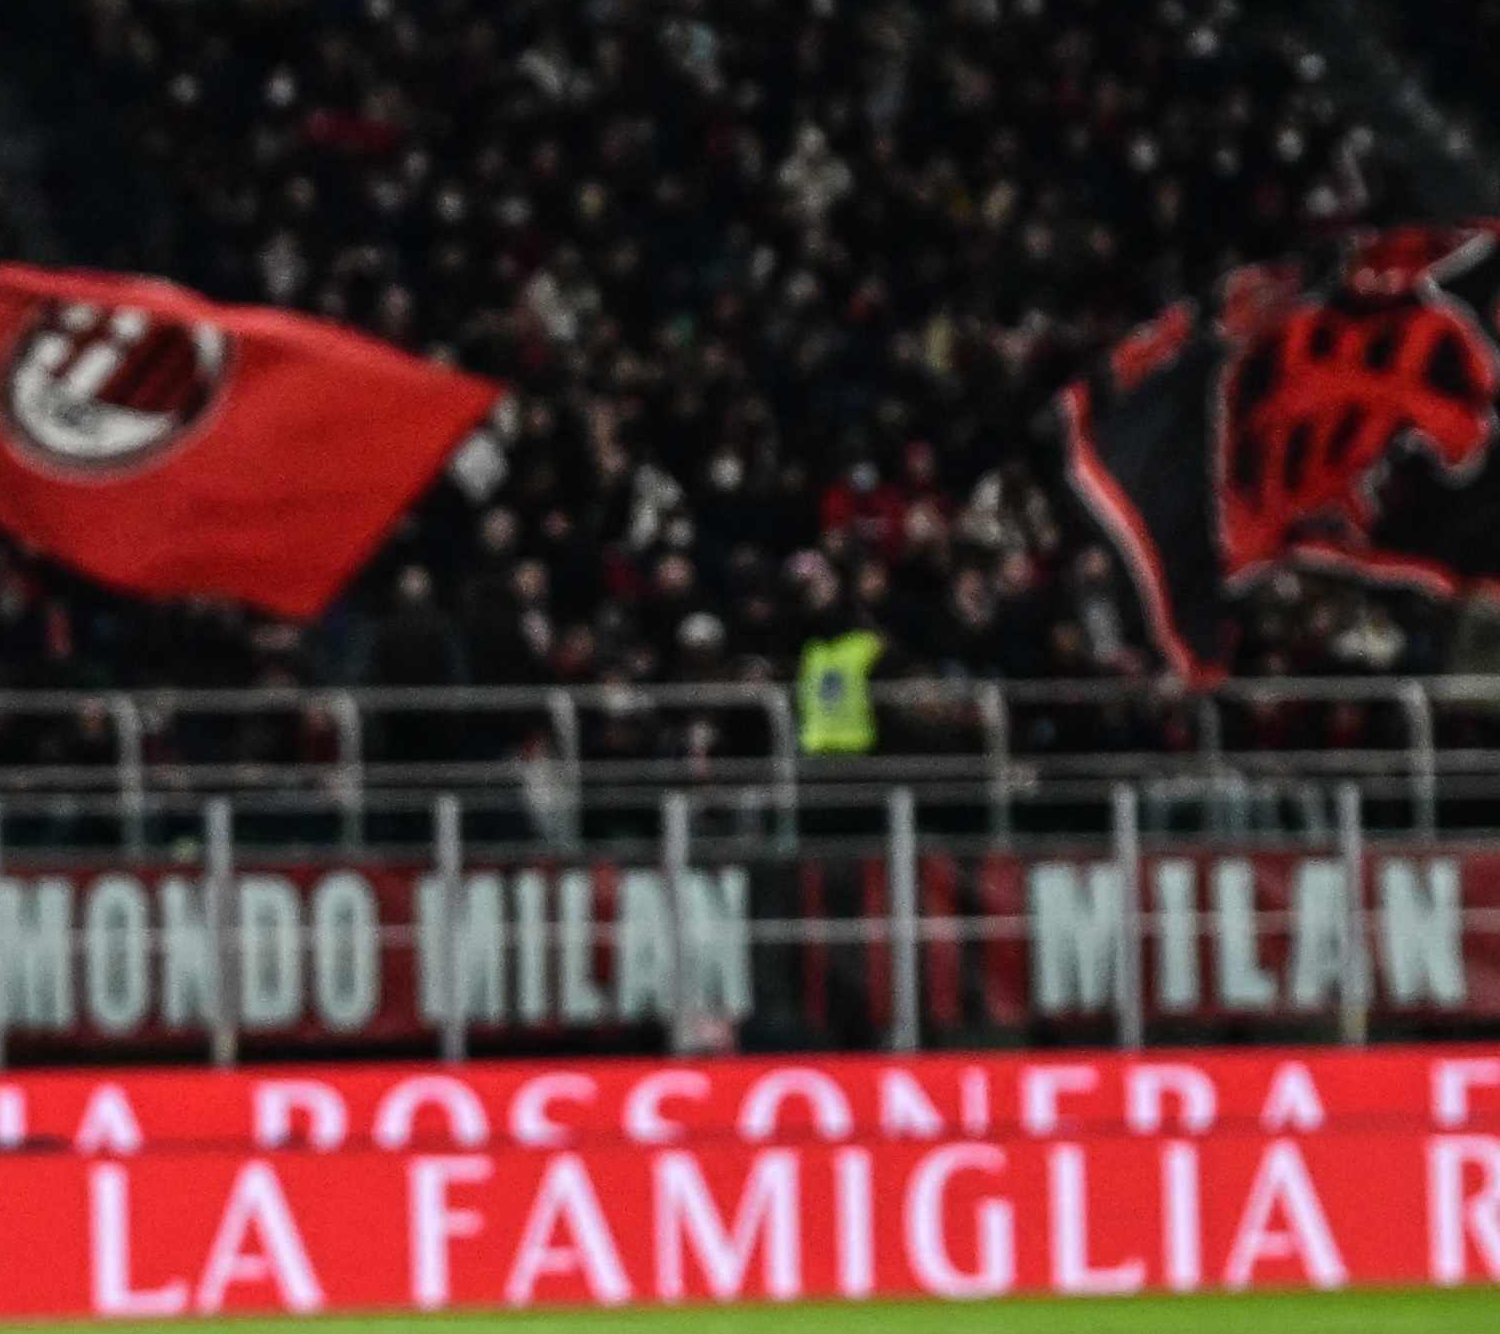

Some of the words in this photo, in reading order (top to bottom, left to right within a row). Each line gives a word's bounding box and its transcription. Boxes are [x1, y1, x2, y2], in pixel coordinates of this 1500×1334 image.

[410, 867, 754, 1029] MILAN
[1024, 855, 1468, 1015] MILAN
[90, 1157, 326, 1319] LA
[406, 1137, 1348, 1315] FAMIGLIA
